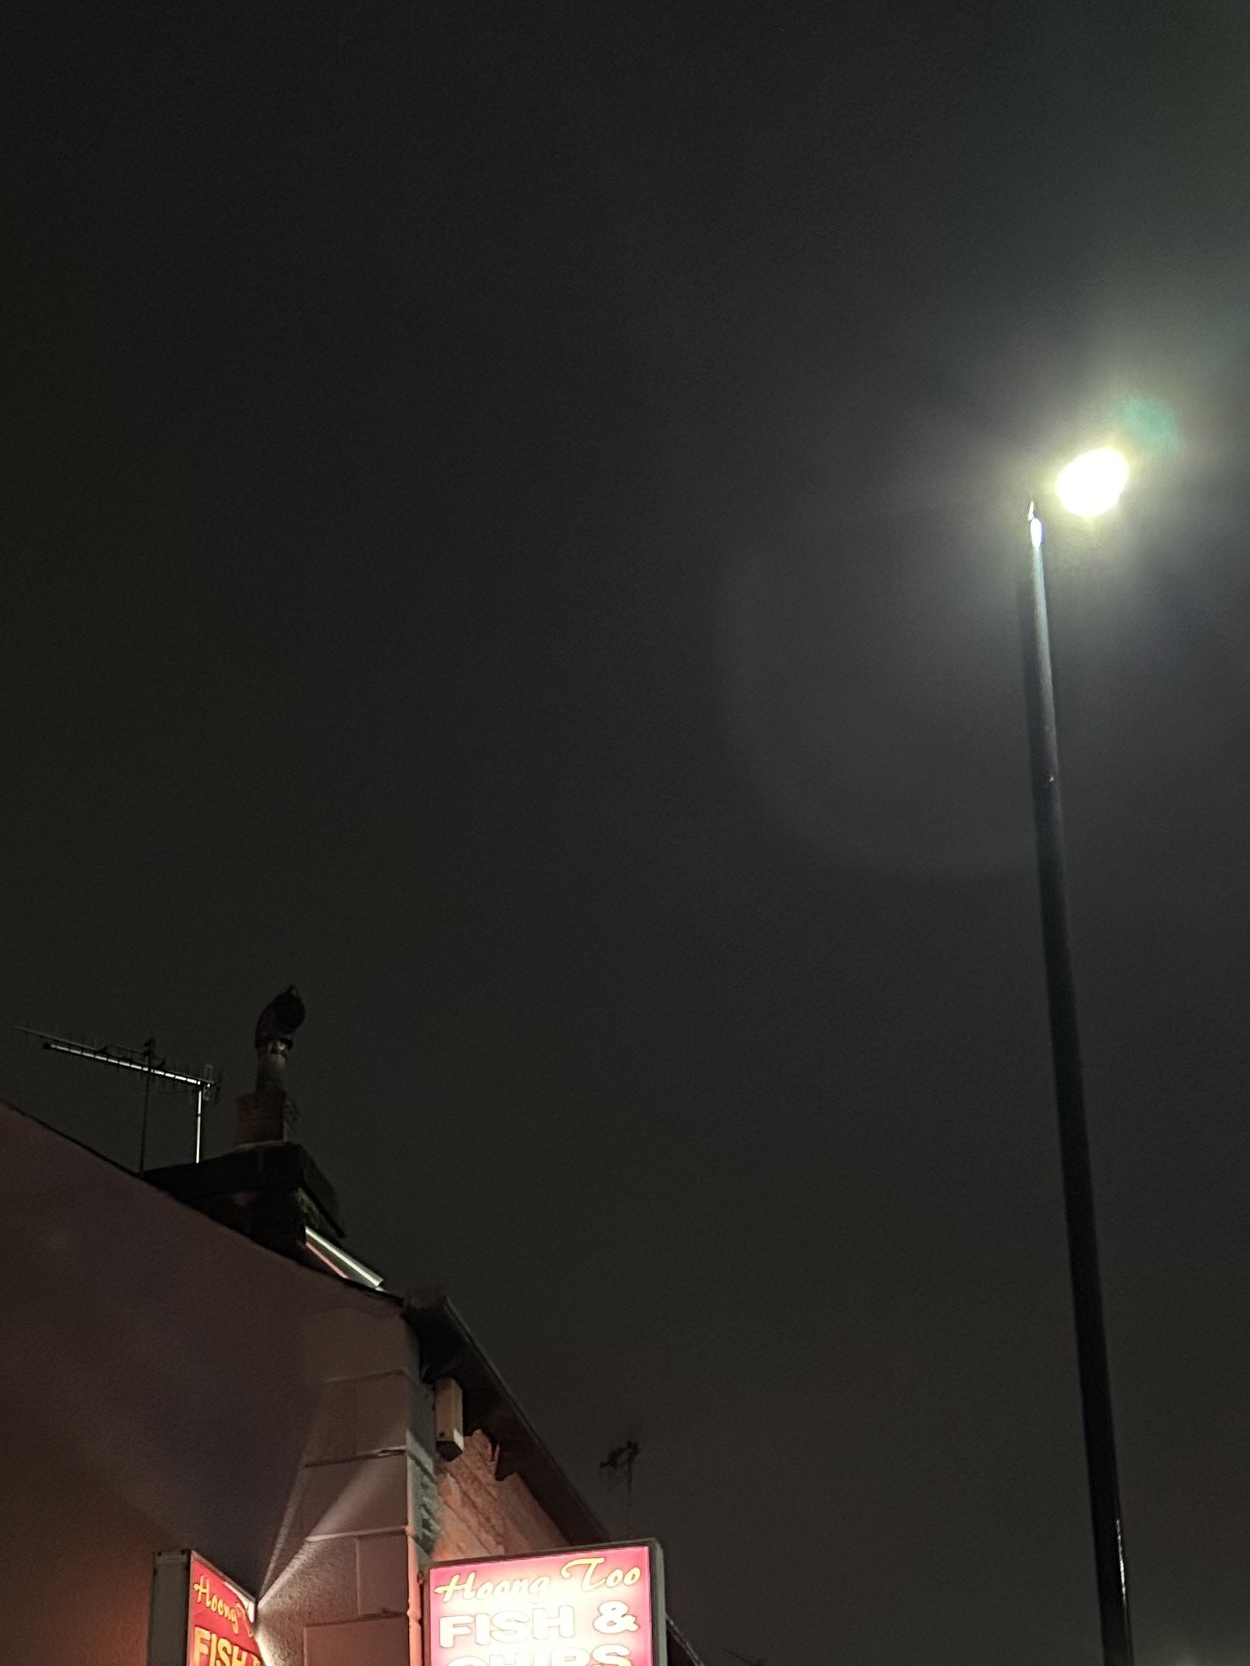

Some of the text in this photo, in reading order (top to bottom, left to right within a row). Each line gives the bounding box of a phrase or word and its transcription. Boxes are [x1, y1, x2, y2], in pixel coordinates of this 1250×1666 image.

[193, 1575, 240, 1634] Hoong
[434, 1557, 641, 1604] Hoong Too
[439, 1600, 640, 1648] FISH &
